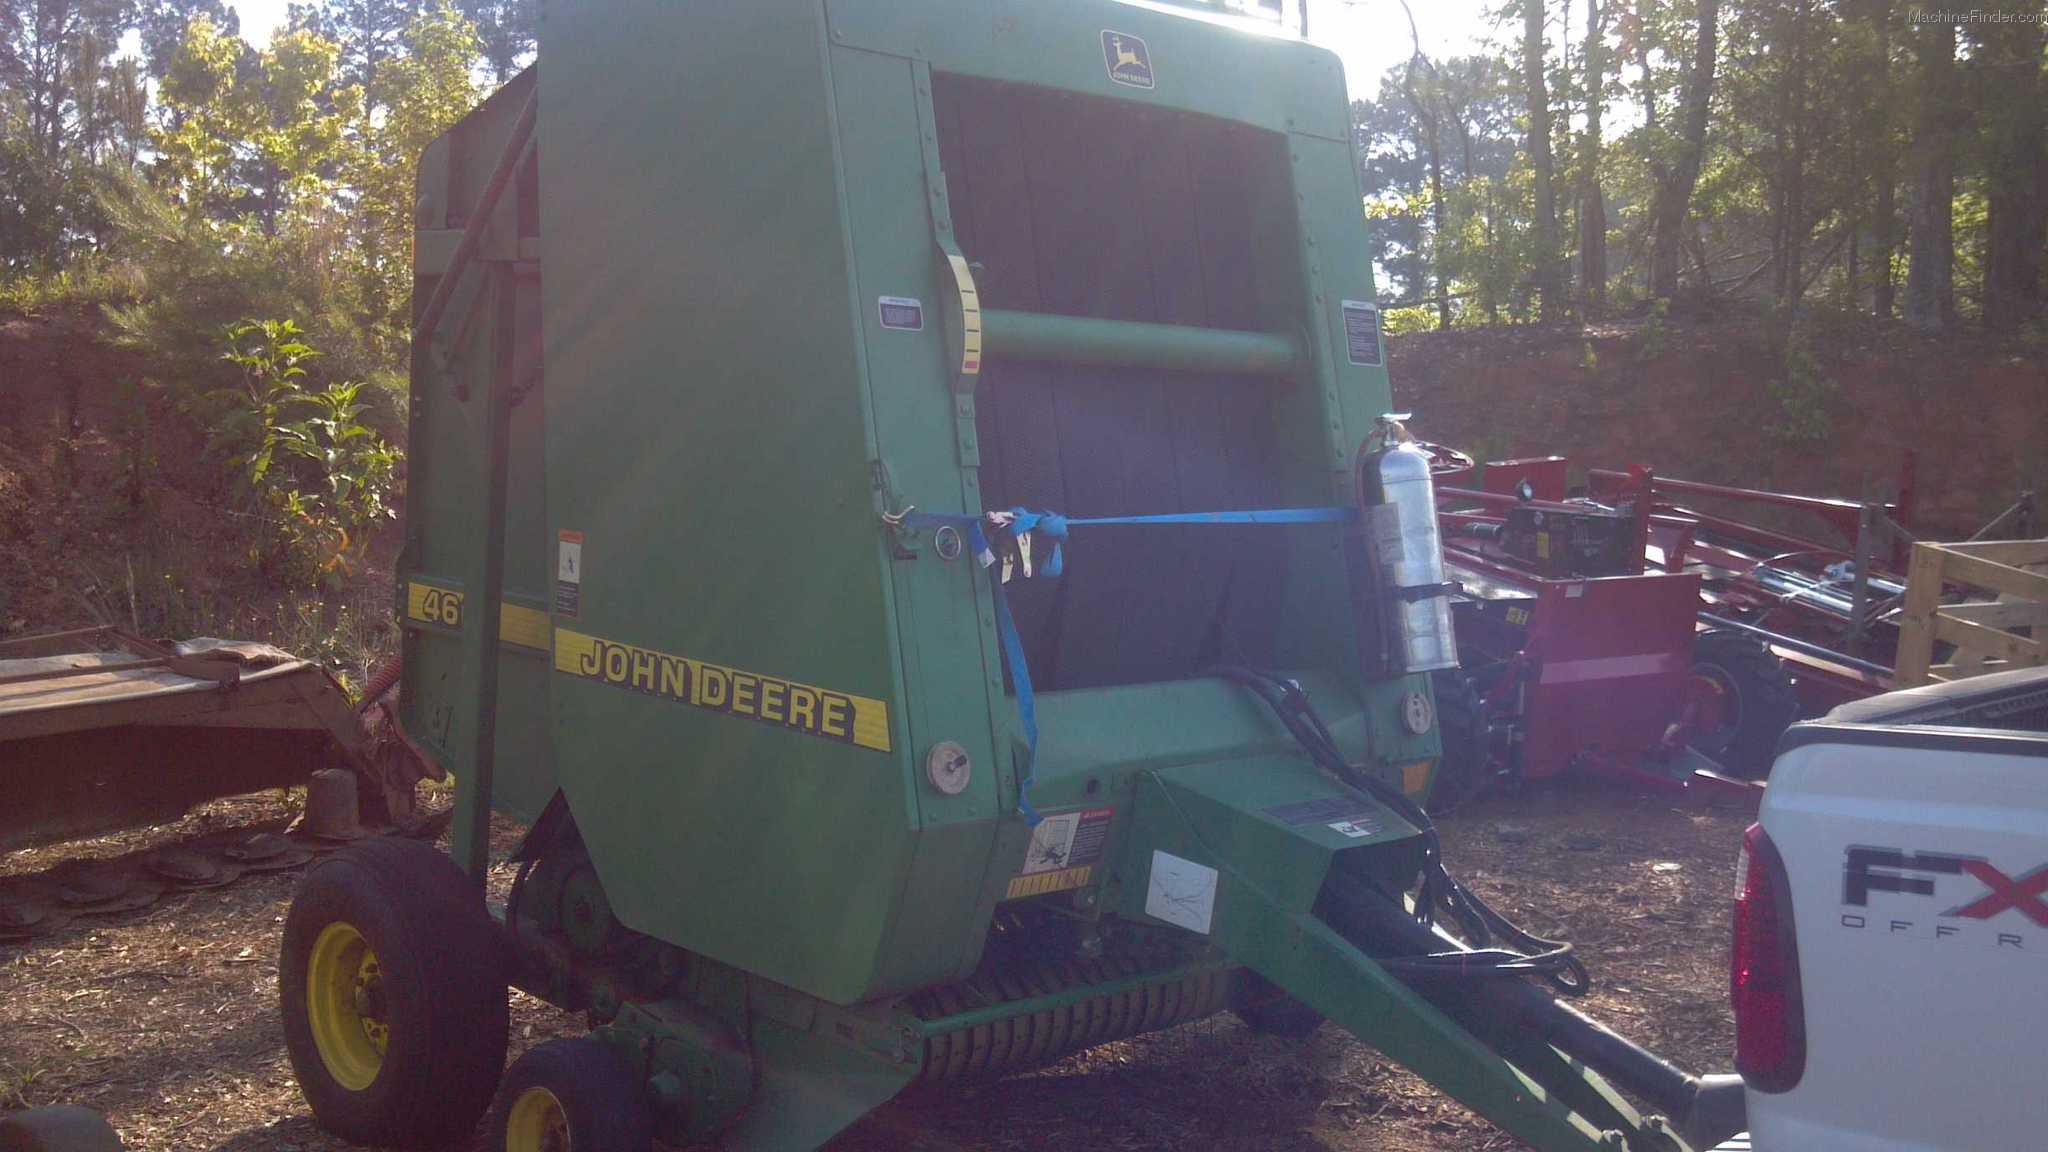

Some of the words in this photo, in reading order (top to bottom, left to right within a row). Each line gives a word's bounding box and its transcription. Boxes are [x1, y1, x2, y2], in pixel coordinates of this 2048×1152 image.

[422, 588, 464, 626] 46
[578, 639, 693, 702] JOHN
[699, 665, 856, 744] DEERE
